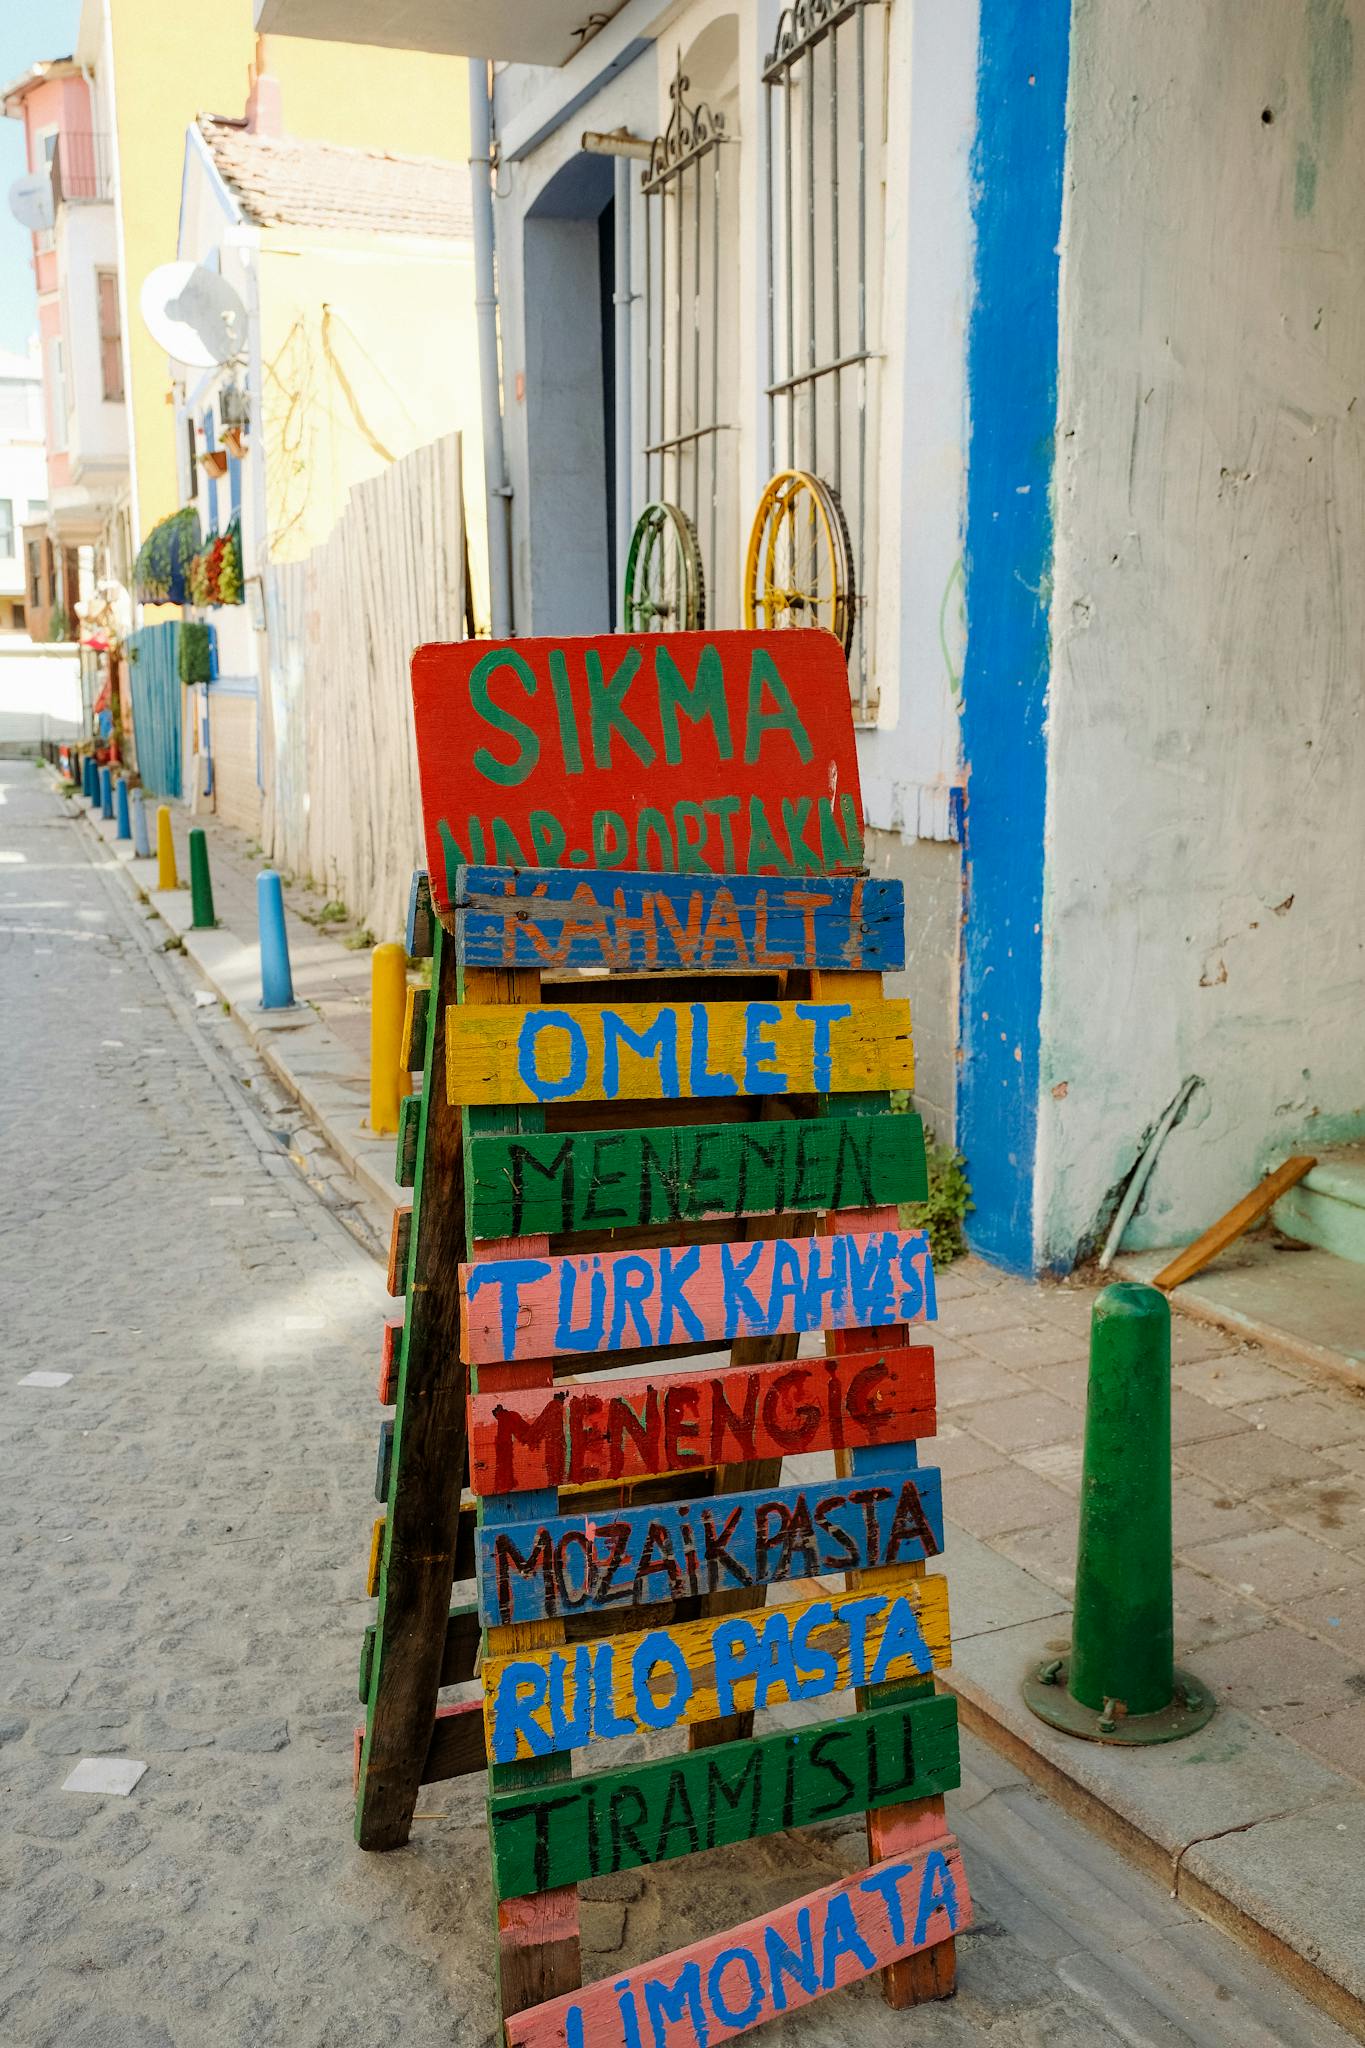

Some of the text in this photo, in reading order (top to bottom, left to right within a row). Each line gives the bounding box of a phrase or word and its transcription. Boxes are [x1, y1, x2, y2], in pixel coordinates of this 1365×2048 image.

[468, 644, 815, 786] SIKMA
[501, 879, 864, 969] KAHVALTI
[516, 1002, 852, 1101] OMLET
[507, 1120, 877, 1236] MENEMEN
[467, 1245, 705, 1361] TÜRK
[755, 1480, 940, 1581] PASTA
[492, 1595, 935, 1764] RULO PASTA
